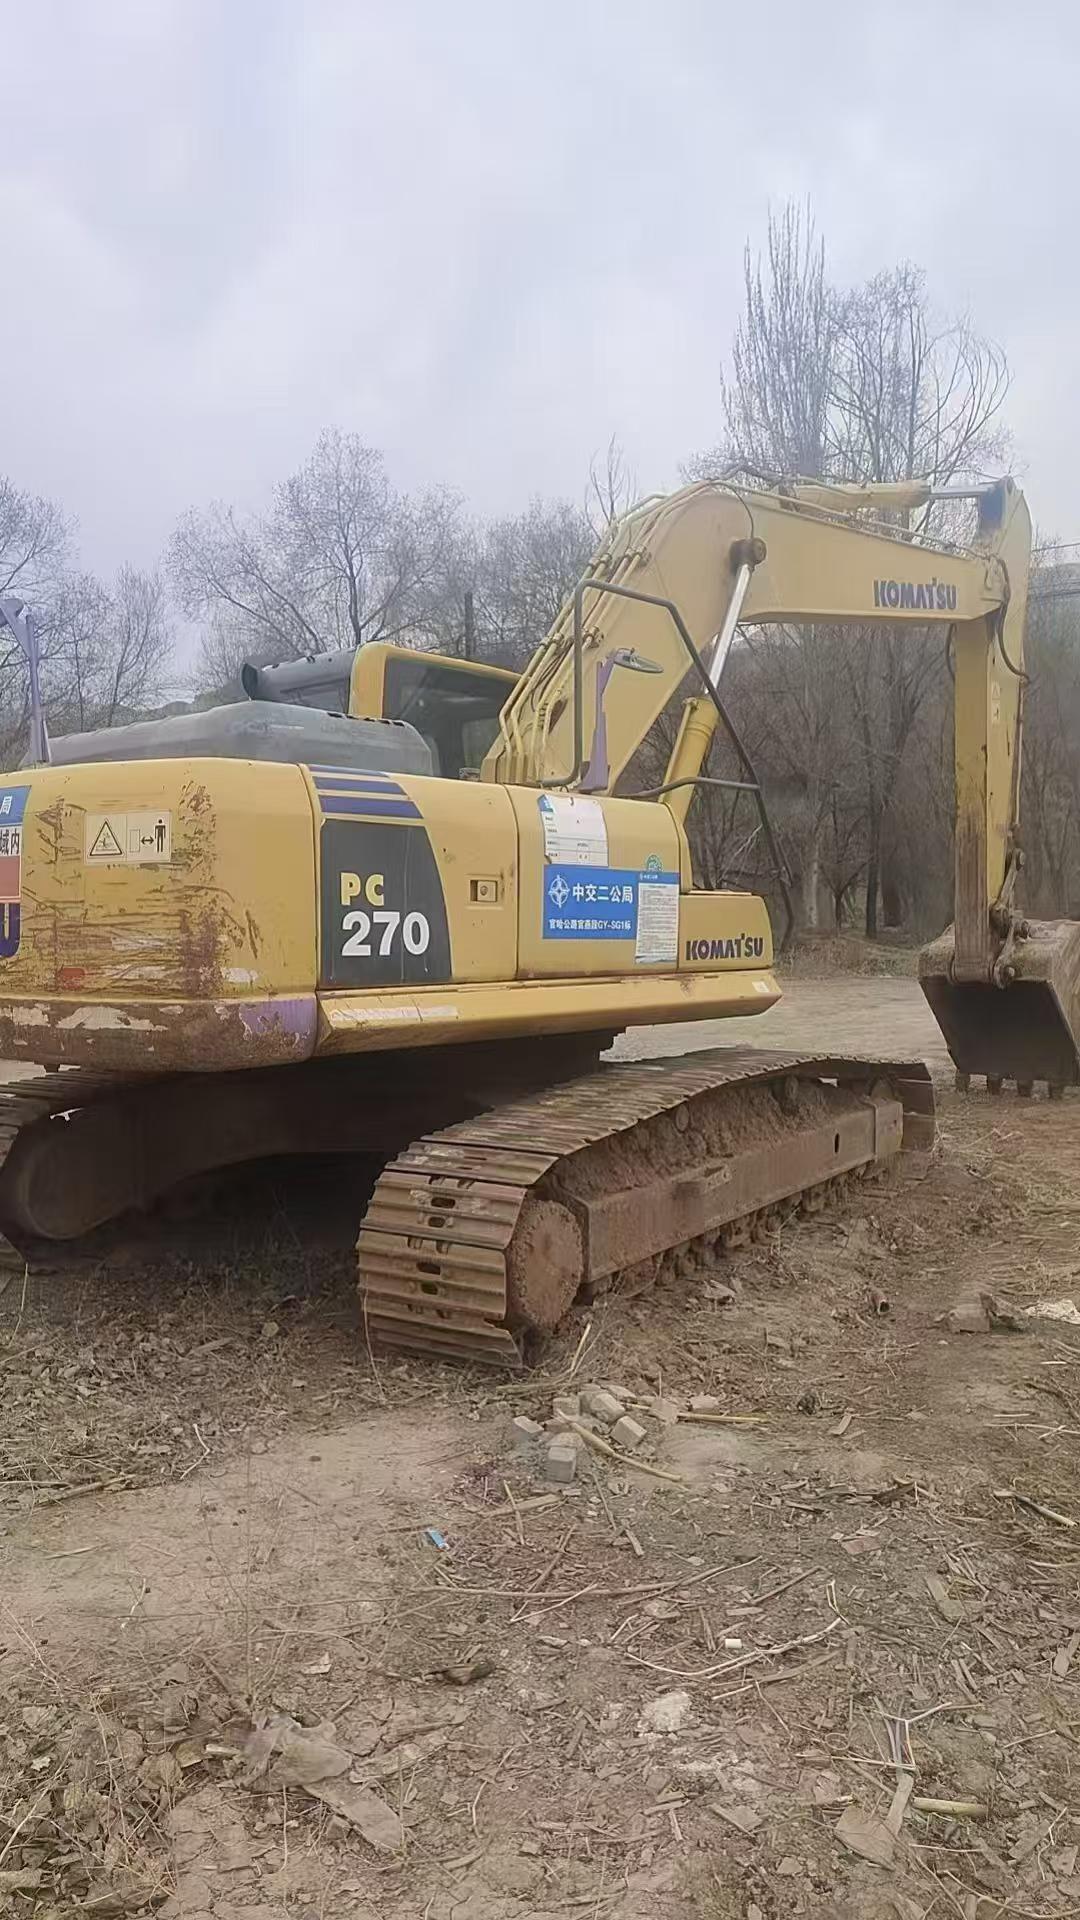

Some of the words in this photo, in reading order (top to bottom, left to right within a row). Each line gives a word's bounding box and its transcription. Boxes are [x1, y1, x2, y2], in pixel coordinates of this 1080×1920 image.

[873, 577, 957, 609] KOMATSU
[0, 796, 12, 815] 局
[340, 872, 385, 906] PC
[572, 883, 633, 904] 中交二公局
[341, 910, 430, 956] 270
[686, 932, 764, 960] KOMATSU
